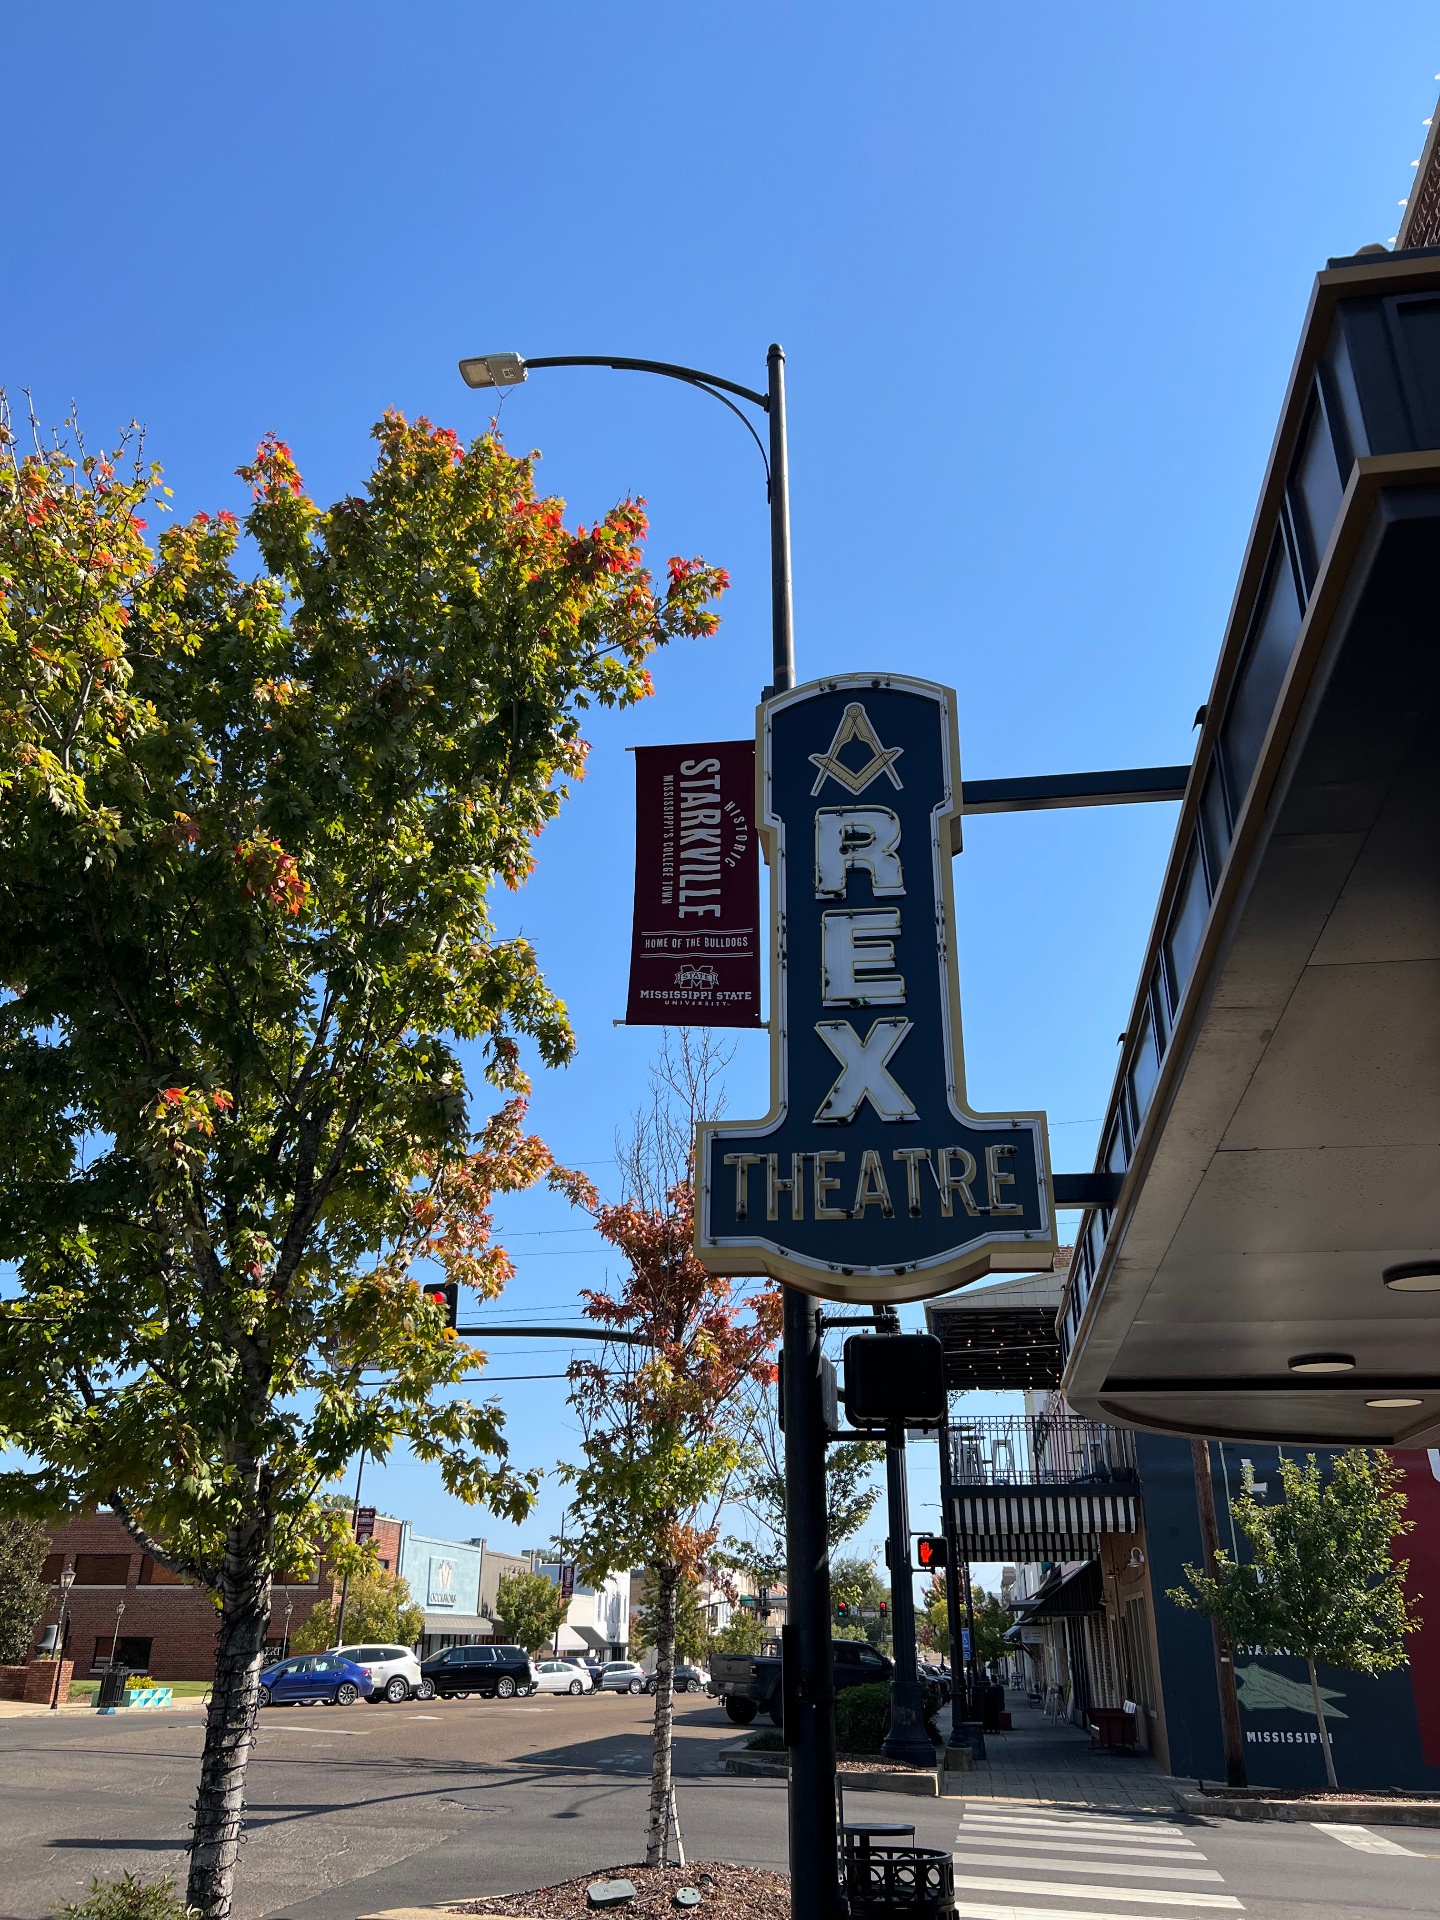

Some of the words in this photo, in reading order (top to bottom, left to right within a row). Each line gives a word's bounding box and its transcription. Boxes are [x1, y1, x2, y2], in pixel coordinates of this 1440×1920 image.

[663, 774, 674, 839] MISSISSIPPI'S
[662, 842, 674, 877] COLLEGE
[679, 758, 721, 919] STARKVILLE
[724, 801, 748, 868] HISTORIC
[661, 881, 673, 905] TOWN
[645, 938, 669, 948] HOME
[672, 938, 682, 948] OF
[686, 937, 701, 948] THE
[704, 936, 748, 948] BULLDOGS
[813, 804, 920, 1123] REX
[640, 990, 712, 1000] MISSISSIPPI
[716, 991, 752, 1000] STATE
[682, 971, 712, 981] STATE
[723, 1144, 1024, 1221] THEATRE
